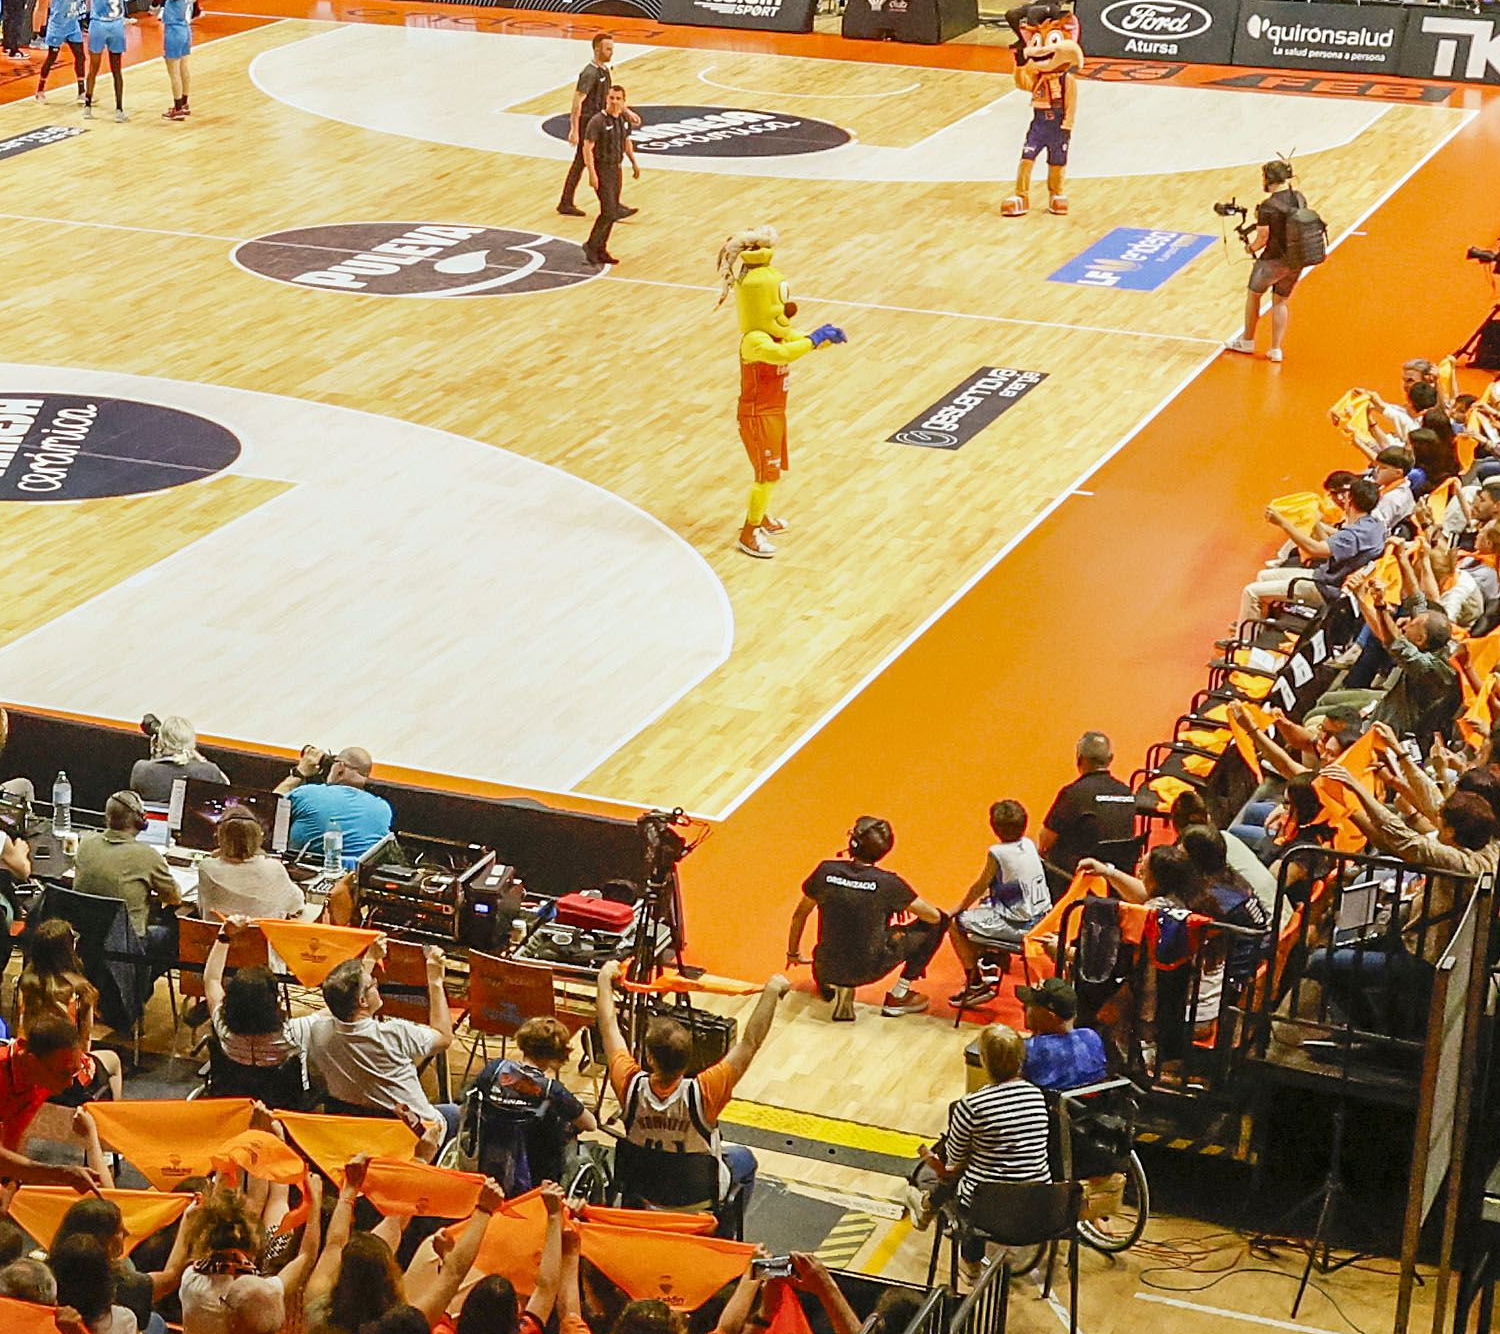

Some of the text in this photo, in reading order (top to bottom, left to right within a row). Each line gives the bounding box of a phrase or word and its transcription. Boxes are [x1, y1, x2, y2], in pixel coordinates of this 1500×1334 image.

[731, 4, 780, 17] SPORT
[1122, 4, 1191, 32] Ford
[1125, 39, 1177, 54] Atursa
[1264, 21, 1394, 49] quirónsalud
[1273, 46, 1284, 56] La
[1287, 46, 1315, 58] salud
[1316, 50, 1347, 62] persona
[1356, 52, 1386, 64] persona
[290, 225, 486, 289] PULEVA
[1120, 230, 1177, 262] endesa
[922, 366, 1017, 432] gesternova
[826, 874, 877, 892] ORGANIZACIÓ
